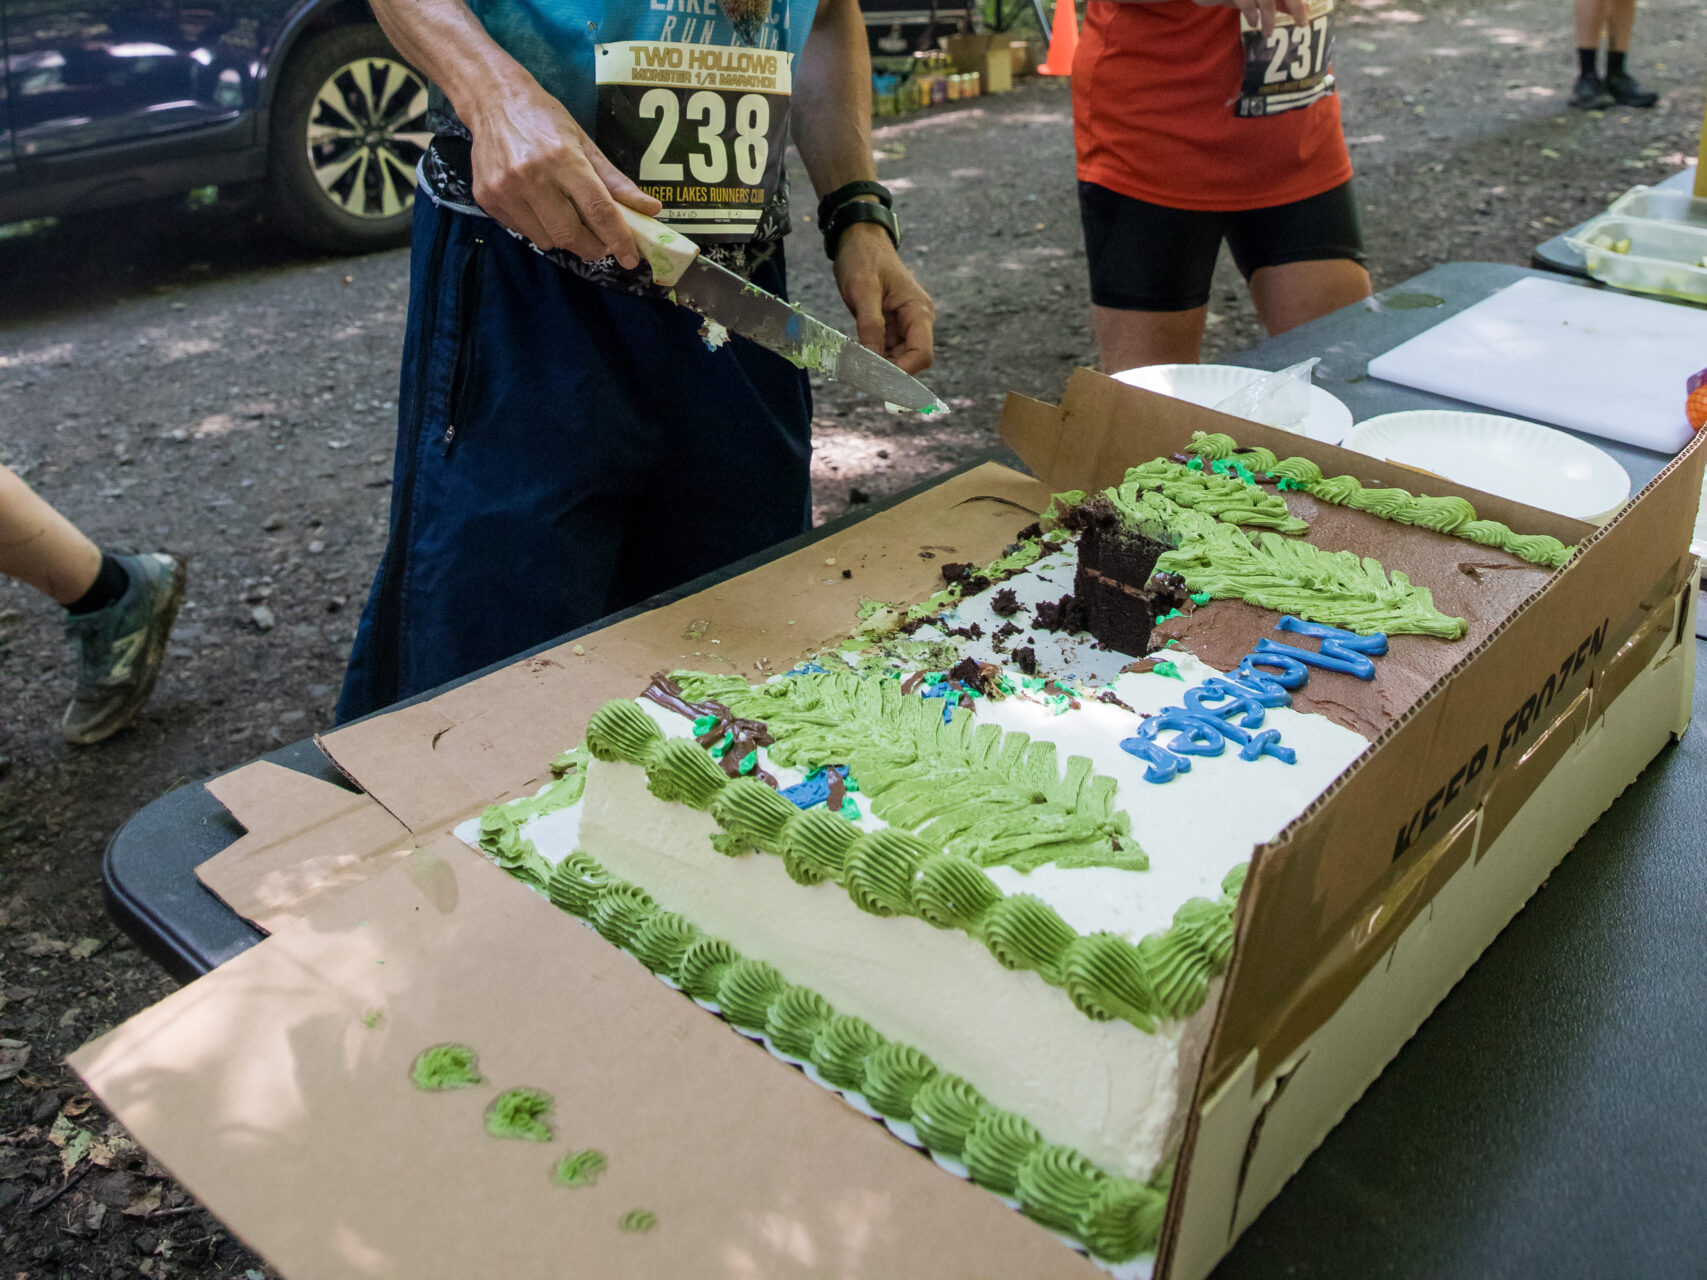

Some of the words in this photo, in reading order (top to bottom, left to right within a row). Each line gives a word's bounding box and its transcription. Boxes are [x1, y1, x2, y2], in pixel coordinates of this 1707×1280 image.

[660, 15, 716, 45] RUN
[629, 46, 683, 69] TWO
[688, 49, 778, 76] HOLLOWS
[1263, 15, 1328, 84] 237
[631, 67, 692, 84] MONSTER
[694, 71, 717, 86] 1/2
[719, 73, 777, 90] MARATHON
[638, 88, 770, 186] 238
[676, 186, 708, 203] LAKES
[709, 187, 749, 203] RUNNERS
[750, 188, 765, 204] CLUB
[1391, 743, 1489, 864] KEEP
